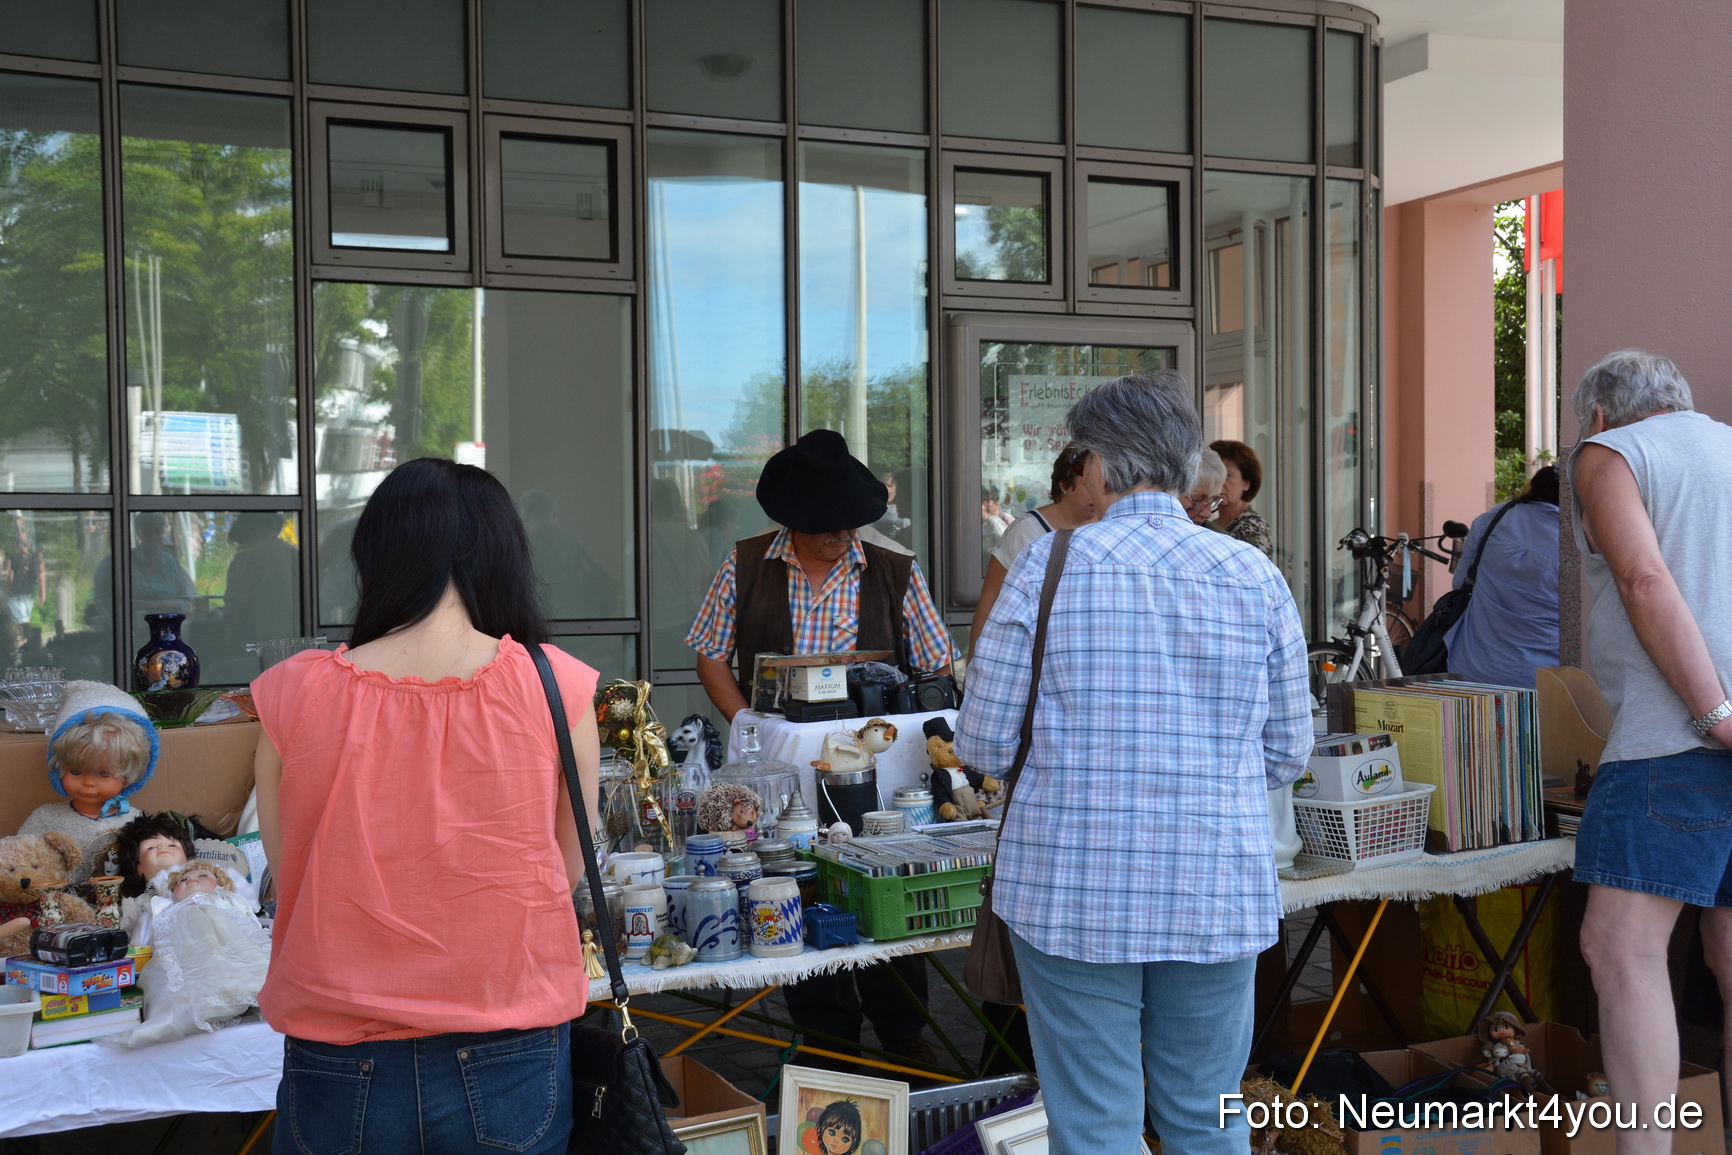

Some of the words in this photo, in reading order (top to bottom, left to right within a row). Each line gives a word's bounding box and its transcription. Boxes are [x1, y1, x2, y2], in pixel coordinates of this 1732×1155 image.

[1023, 424, 1041, 436] Wir
[1377, 719, 1404, 734] Mozart
[1356, 764, 1389, 785] Auland
[195, 848, 229, 861] Zertifikat
[1422, 939, 1479, 971] Netto
